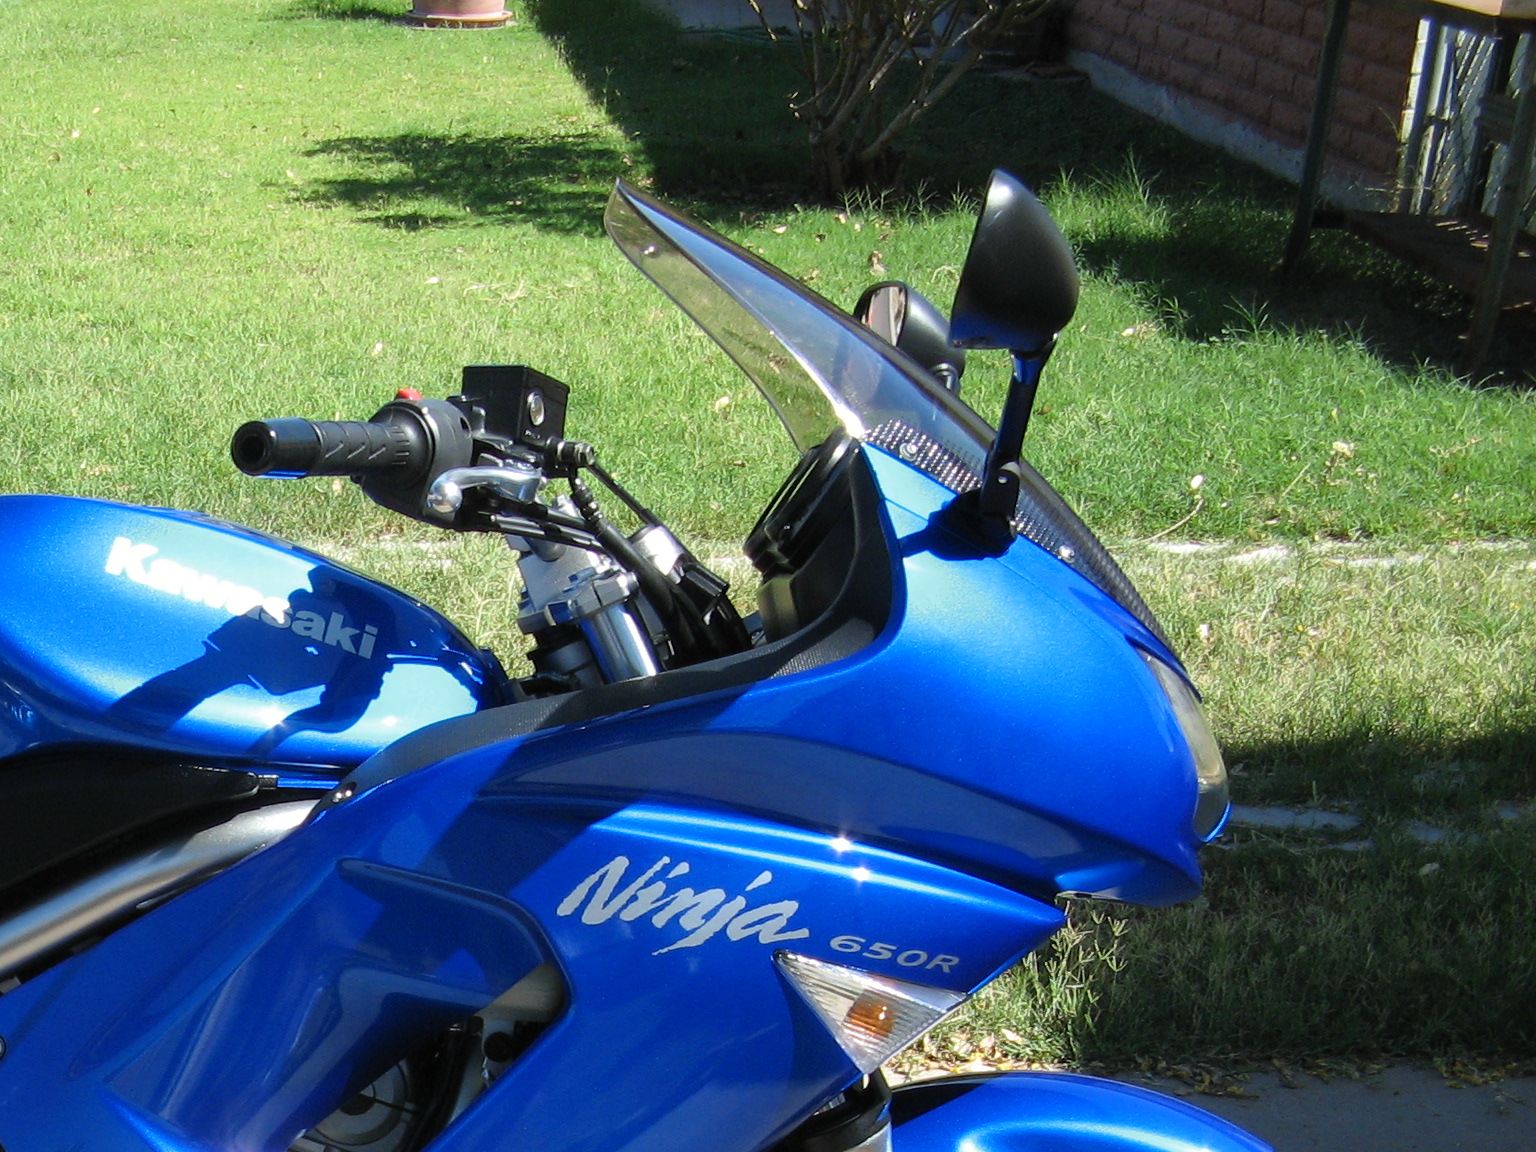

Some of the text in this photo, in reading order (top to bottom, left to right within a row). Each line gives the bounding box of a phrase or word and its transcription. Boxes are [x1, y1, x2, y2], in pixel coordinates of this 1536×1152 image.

[105, 537, 377, 659] Kawasaki
[558, 856, 960, 973] Ninja 650R
